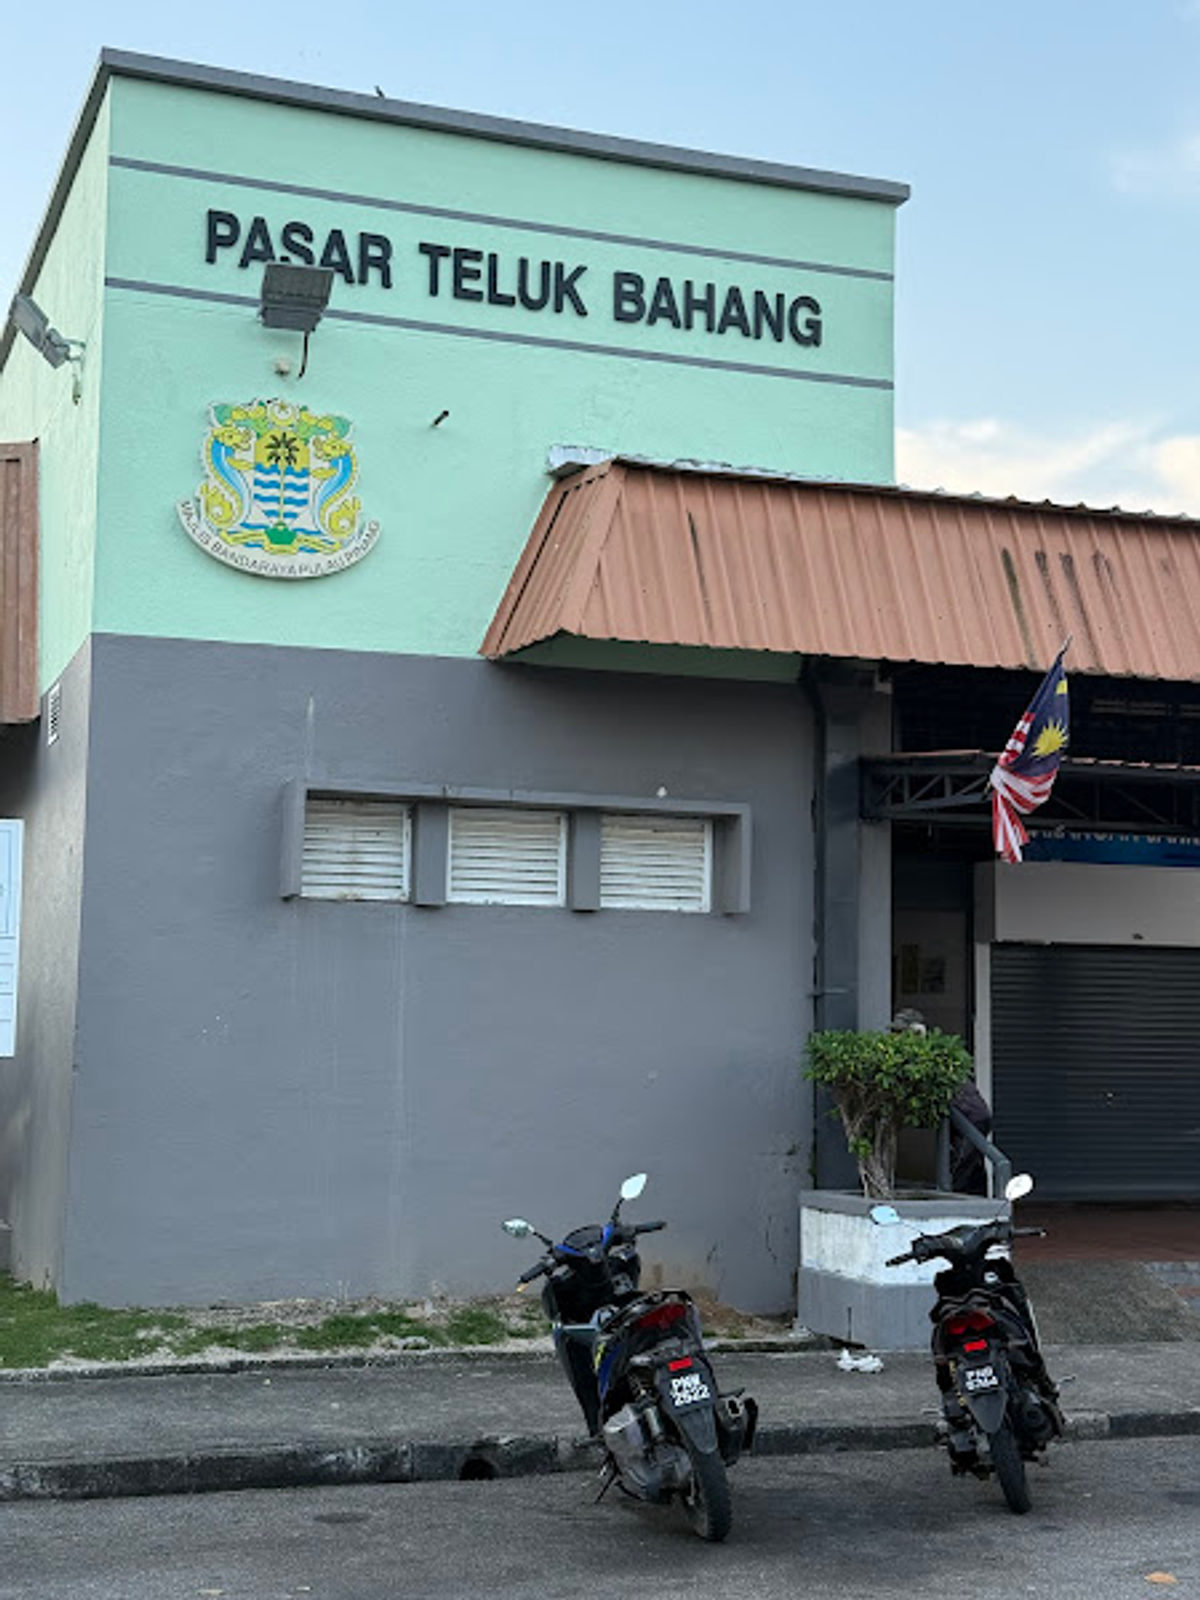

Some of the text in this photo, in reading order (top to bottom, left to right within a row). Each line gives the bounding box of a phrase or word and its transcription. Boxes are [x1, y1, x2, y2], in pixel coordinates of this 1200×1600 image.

[205, 208, 823, 348] PASAR TELUK BAHANG
